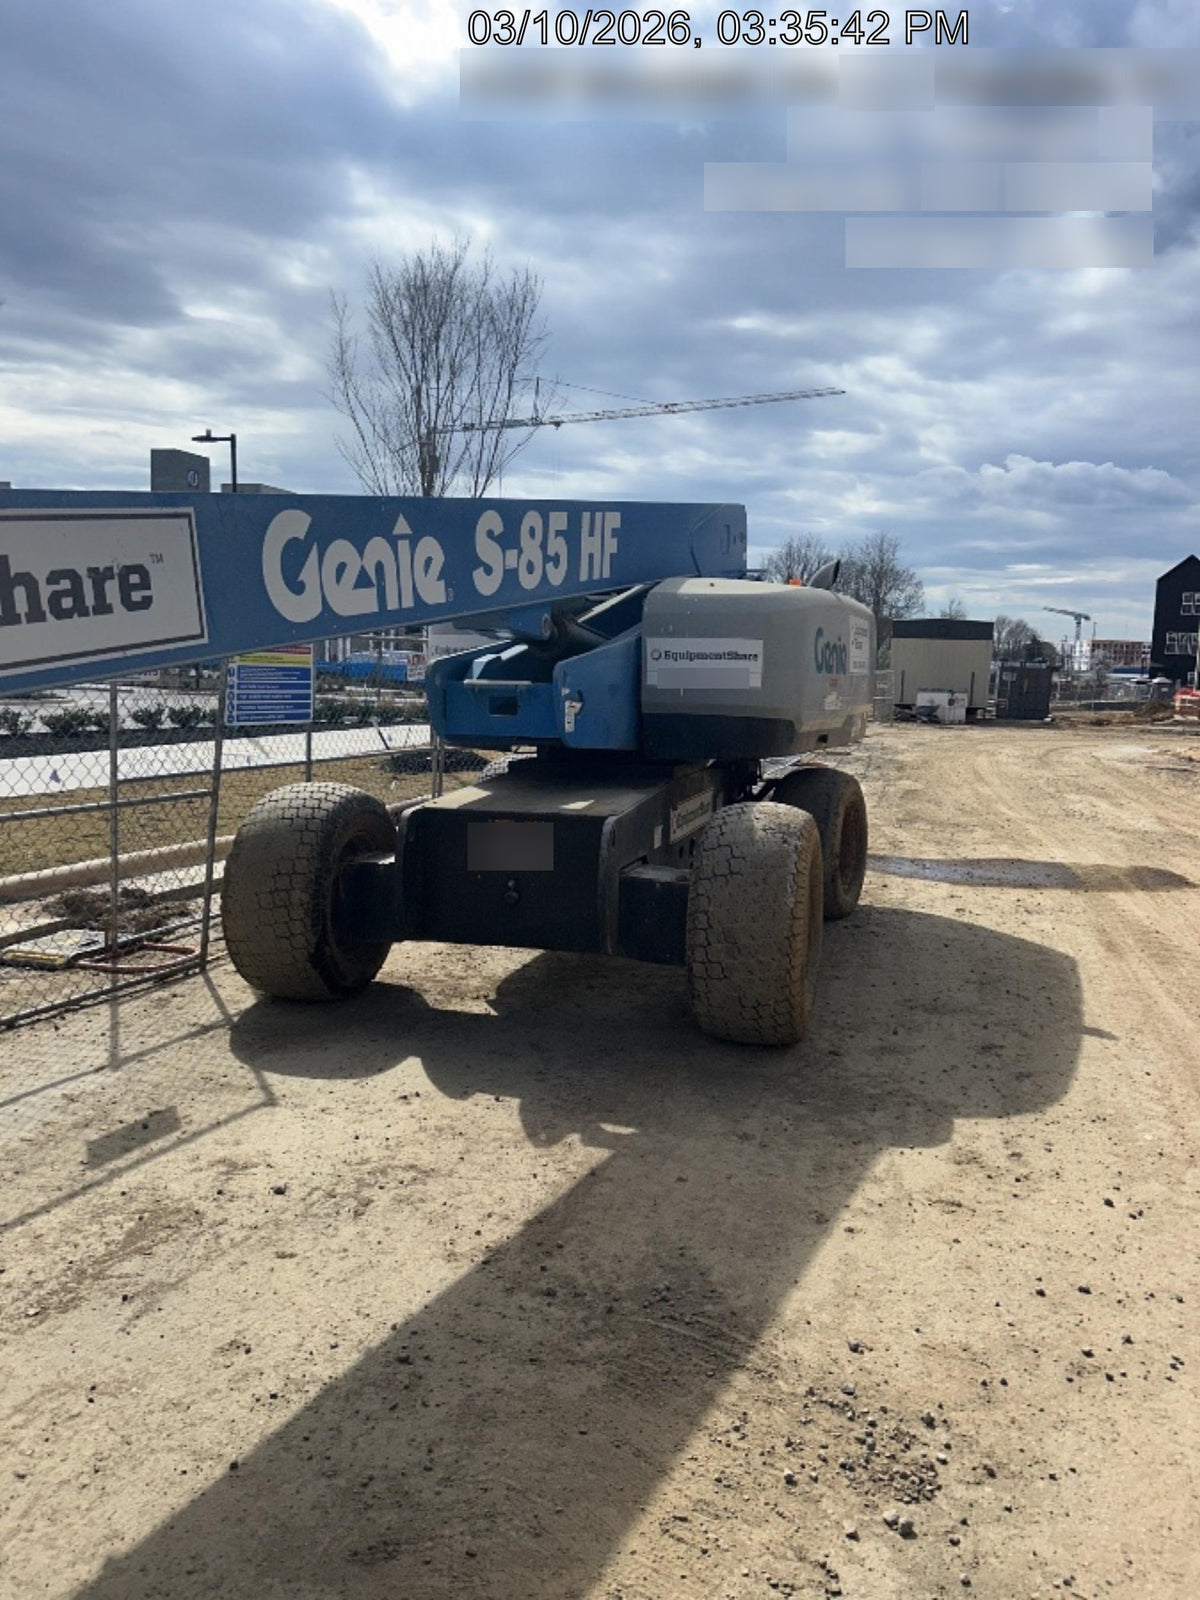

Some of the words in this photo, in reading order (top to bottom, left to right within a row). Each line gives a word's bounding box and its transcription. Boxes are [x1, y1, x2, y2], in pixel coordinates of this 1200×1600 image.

[262, 509, 447, 623] Genie
[472, 509, 568, 597] S-85
[579, 511, 622, 583] HF
